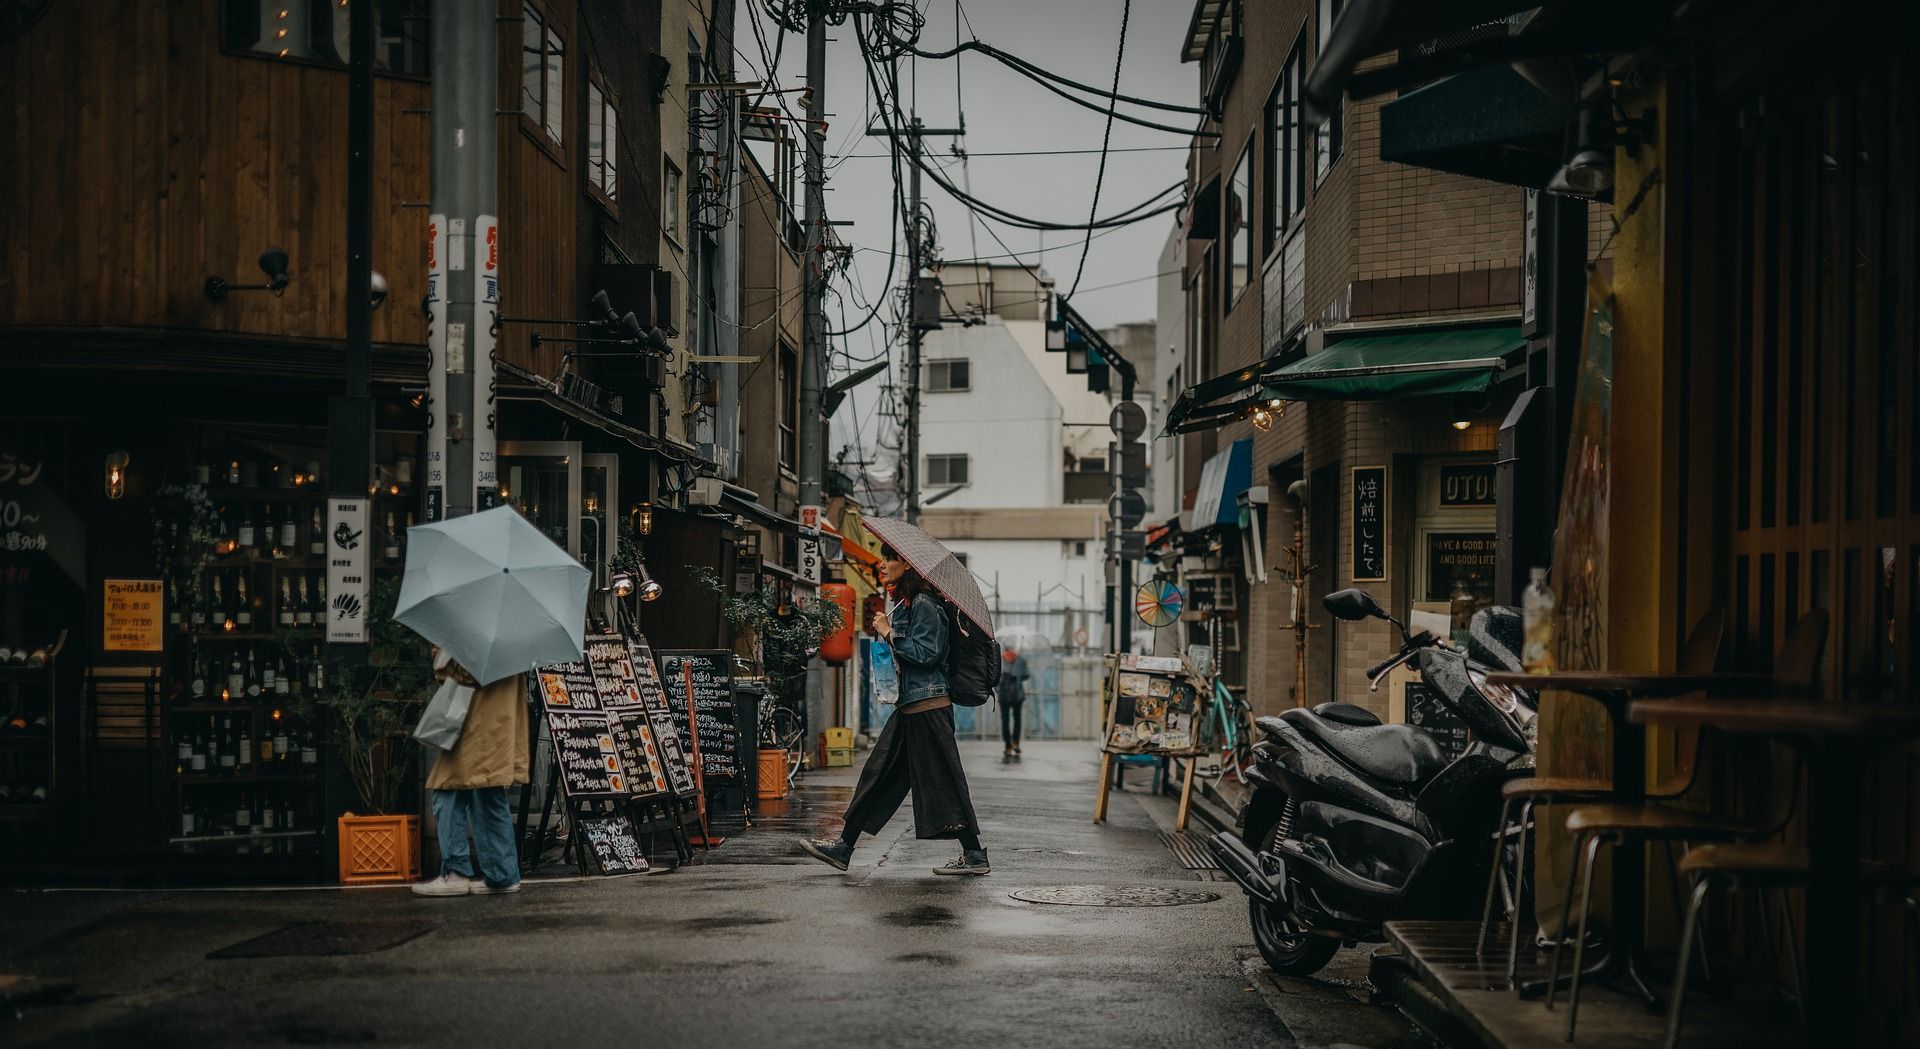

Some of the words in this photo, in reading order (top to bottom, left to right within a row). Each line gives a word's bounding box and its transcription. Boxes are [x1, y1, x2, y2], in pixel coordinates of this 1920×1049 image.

[1358, 478, 1377, 571] 焙煎したて
[1433, 540, 1454, 550] HAVE
[1455, 540, 1461, 550] A
[1462, 540, 1483, 550] GOOD
[1440, 554, 1455, 565] AND
[1457, 554, 1477, 565] GOOD
[1479, 554, 1496, 565] LIFE
